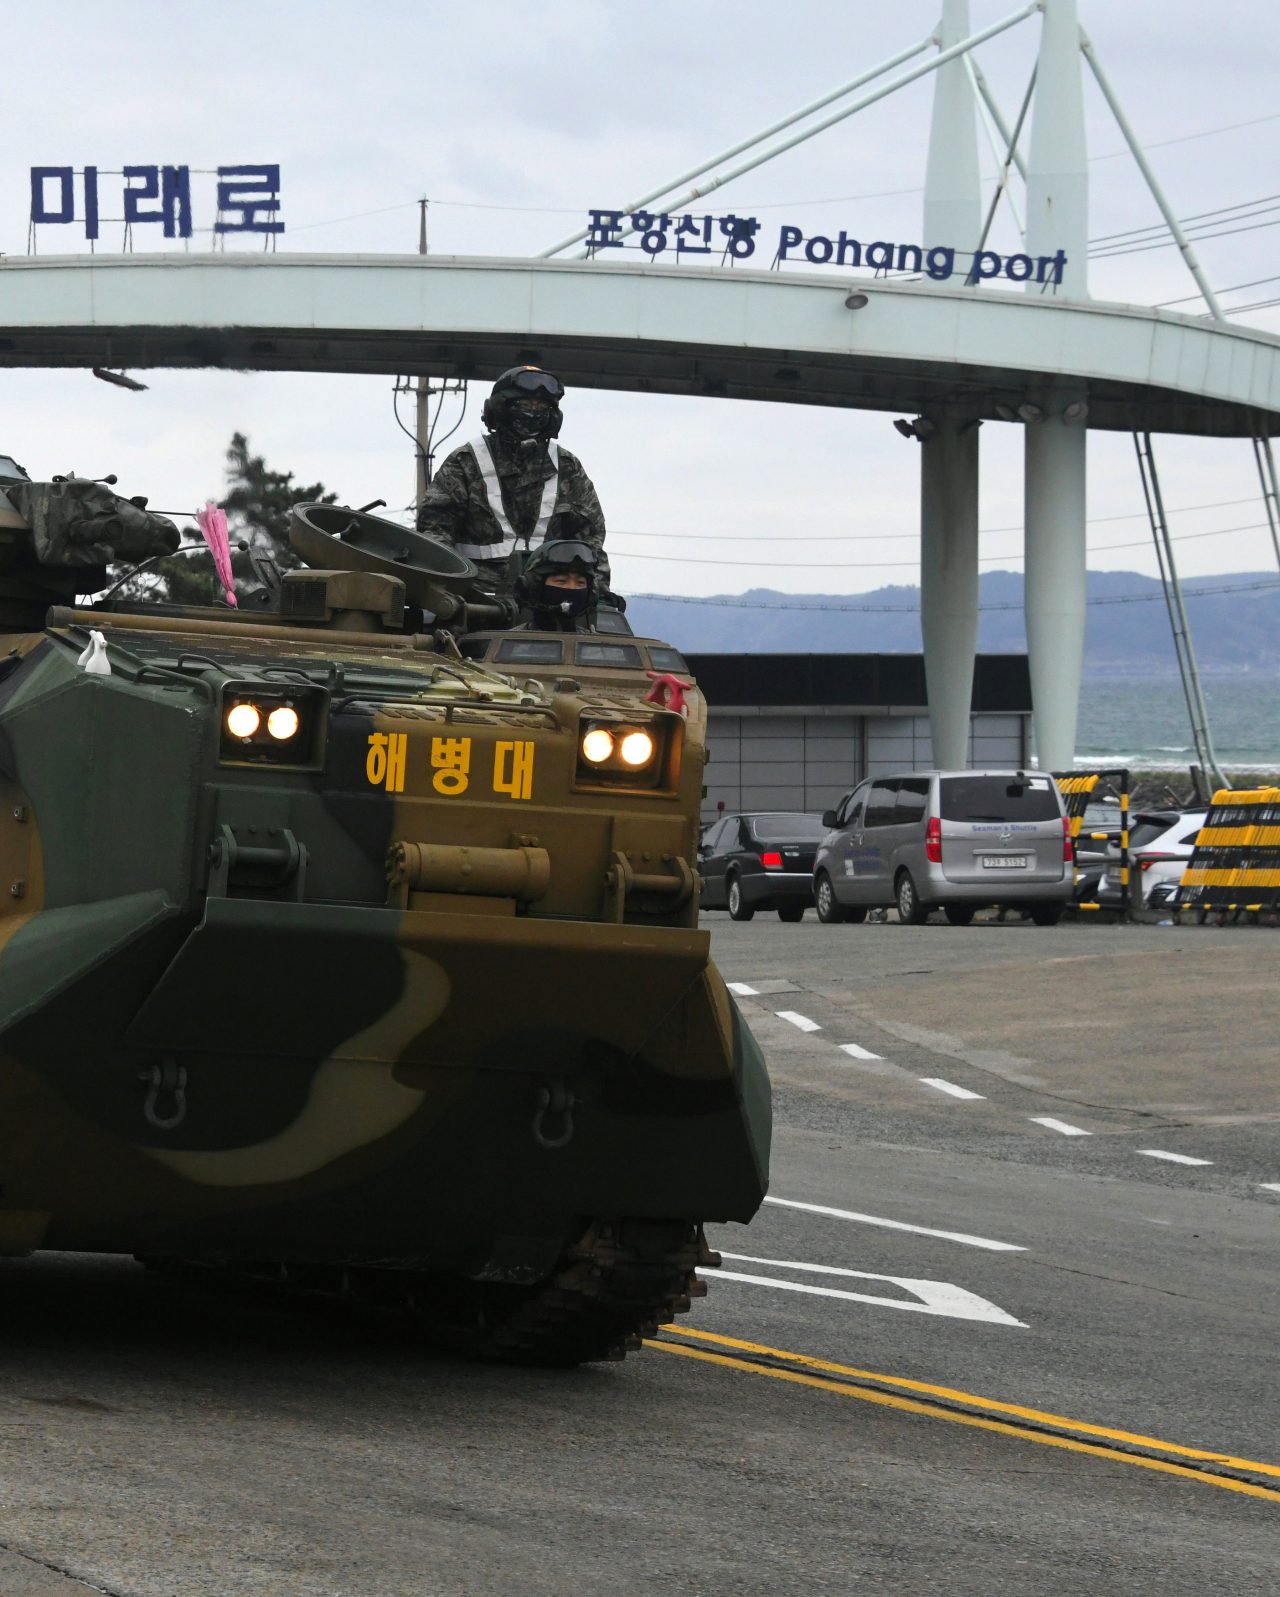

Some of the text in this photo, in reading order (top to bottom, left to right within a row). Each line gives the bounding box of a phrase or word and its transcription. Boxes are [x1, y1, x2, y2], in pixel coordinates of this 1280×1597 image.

[30, 163, 285, 240] 미래로
[585, 208, 1068, 286] 포항신항 Pohang port
